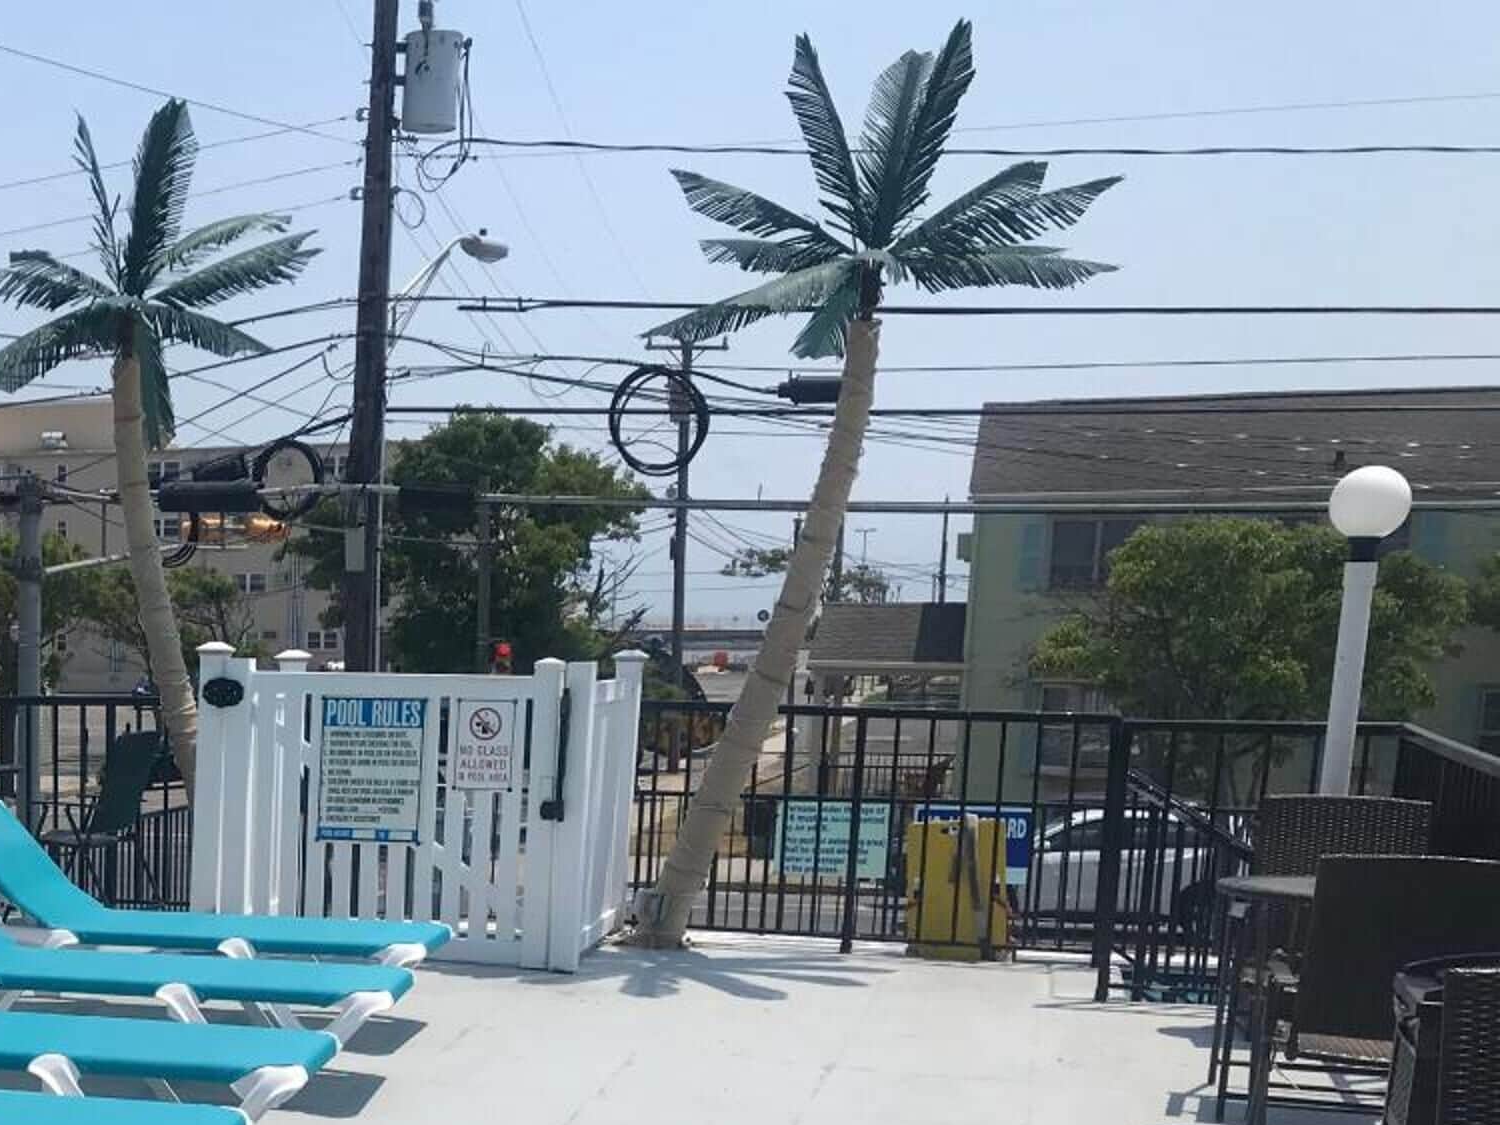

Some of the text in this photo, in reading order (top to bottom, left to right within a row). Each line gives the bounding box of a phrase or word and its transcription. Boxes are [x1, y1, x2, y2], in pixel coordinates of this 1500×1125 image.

[326, 699, 421, 727] POOL RULES
[459, 744, 509, 757] NO GLASS
[459, 758, 507, 769] ALLOWED
